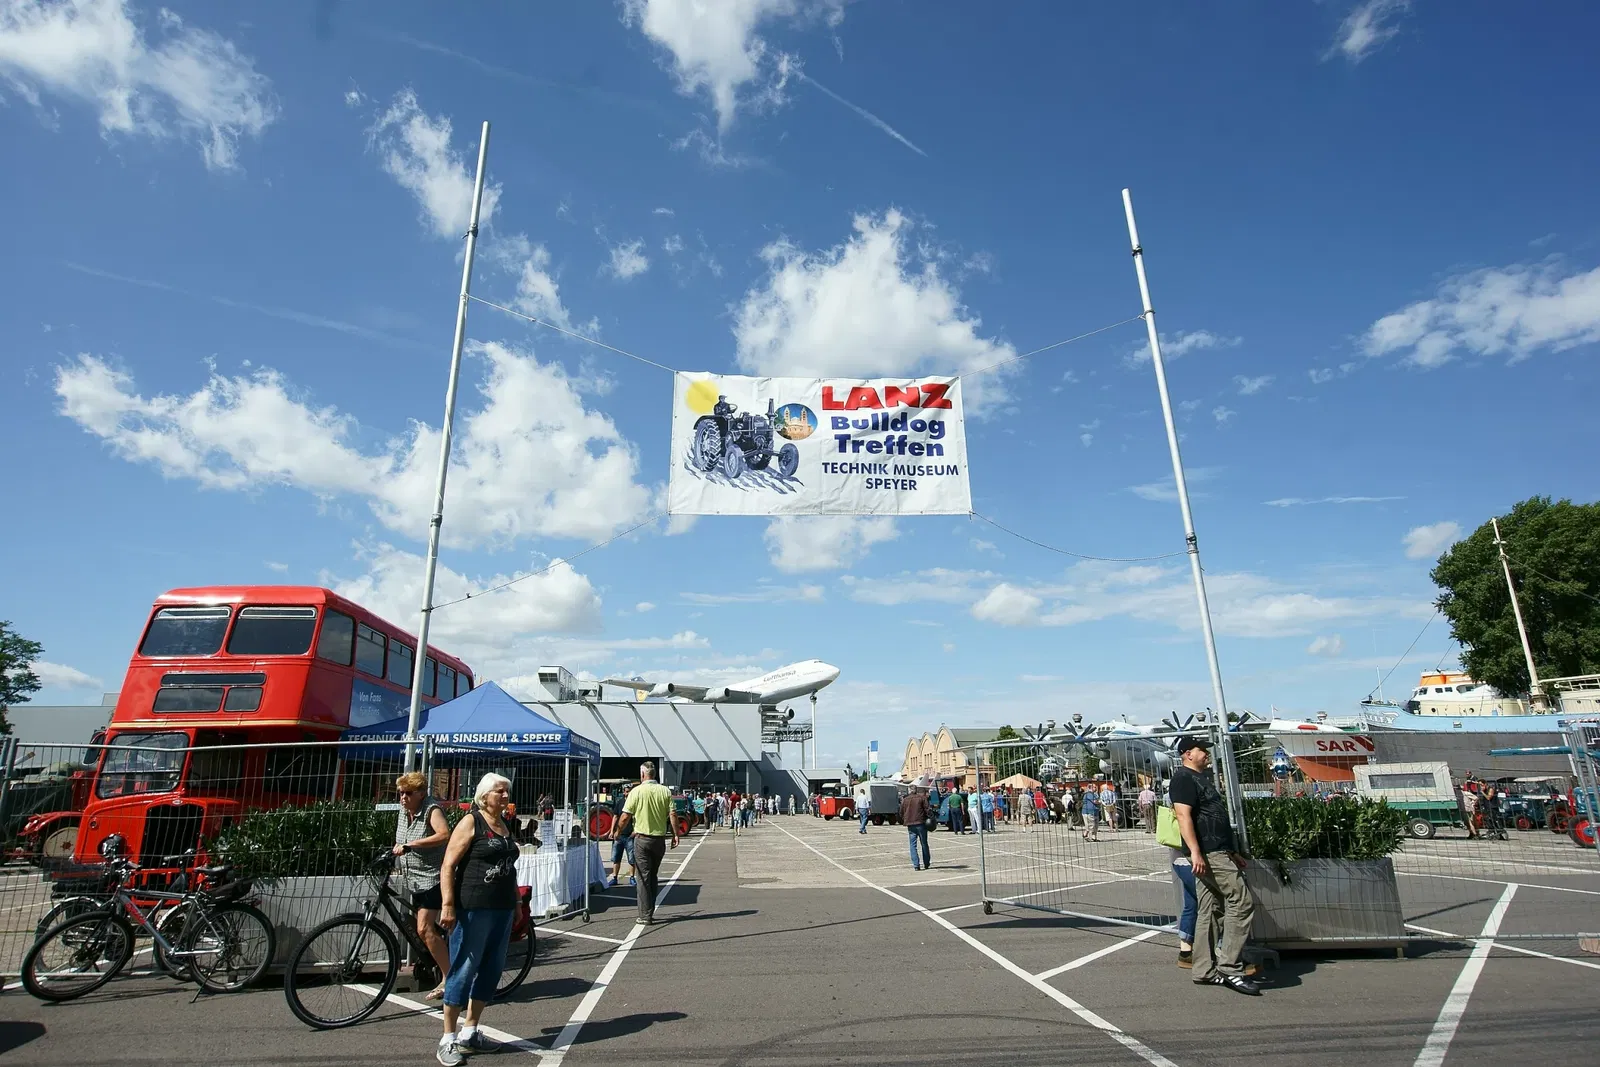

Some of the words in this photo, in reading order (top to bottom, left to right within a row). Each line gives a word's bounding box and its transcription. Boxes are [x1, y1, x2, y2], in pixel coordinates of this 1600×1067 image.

[822, 383, 952, 411] LANZ
[831, 412, 945, 440] Bulldog
[834, 433, 944, 457] Treffen
[822, 462, 889, 475] TECHNIK
[893, 464, 959, 476] MUSEUM
[865, 478, 917, 490] SPEYER
[359, 691, 369, 702] Von
[347, 734, 398, 742] TECHNIK
[400, 733, 449, 743] MSUM
[452, 733, 508, 743] SINSHEIM
[510, 733, 520, 743] &
[522, 733, 562, 743] SPEYER
[1316, 740, 1358, 752] SAR
